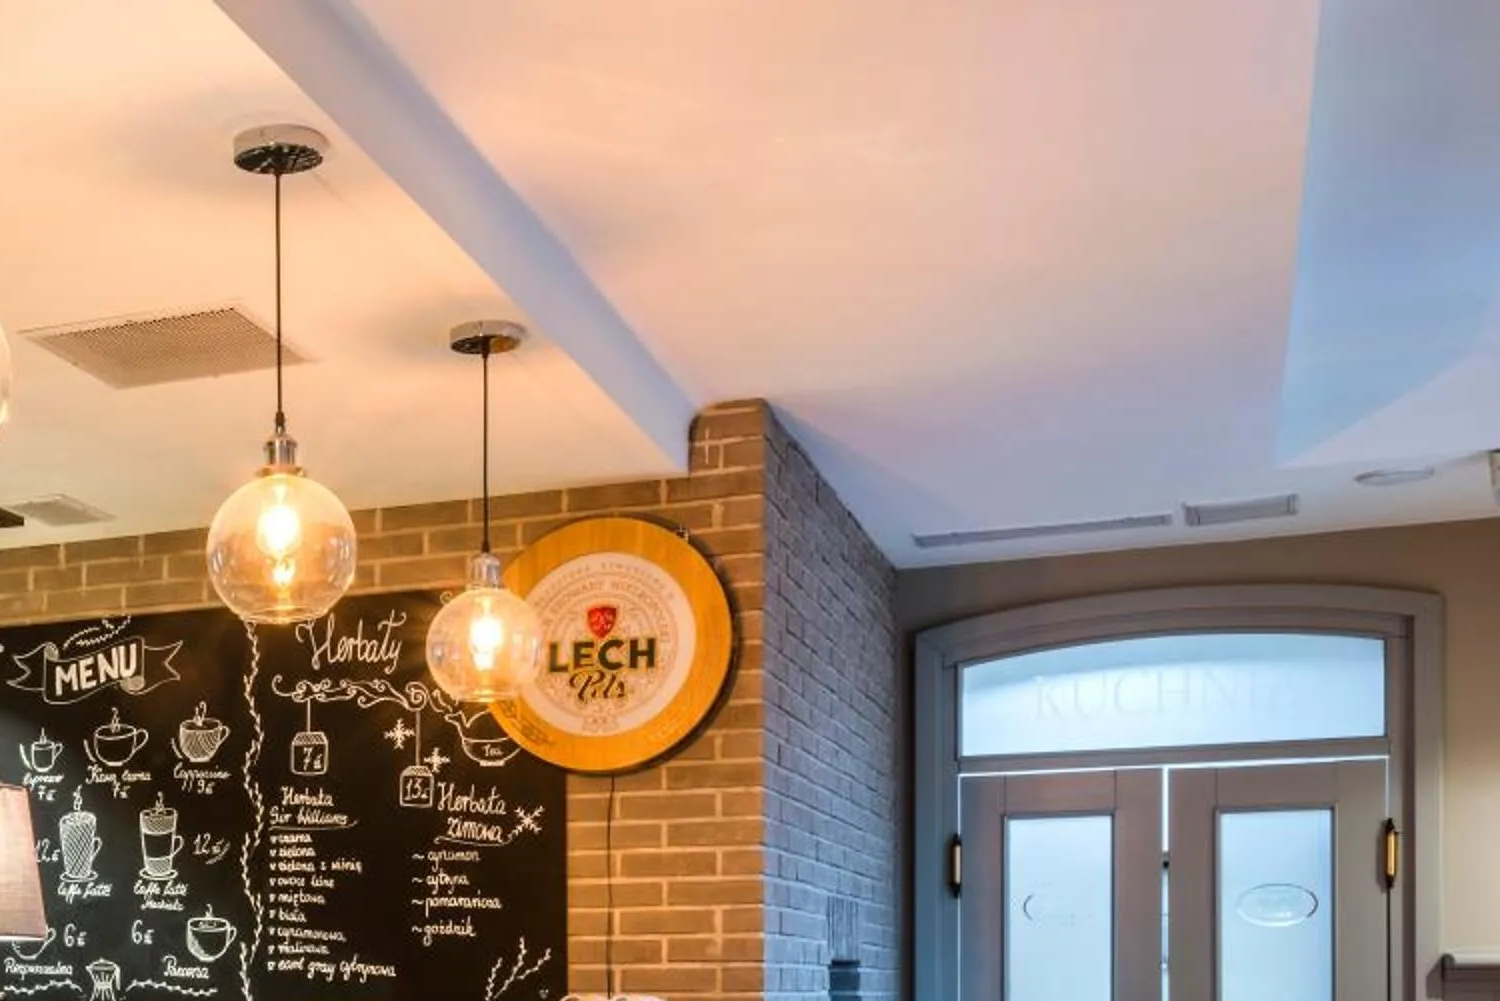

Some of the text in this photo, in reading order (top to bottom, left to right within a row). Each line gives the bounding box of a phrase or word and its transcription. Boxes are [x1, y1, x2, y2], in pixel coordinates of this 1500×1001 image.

[54, 643, 138, 697] MENU
[548, 637, 656, 674] LECH
[568, 669, 626, 702] Pils
